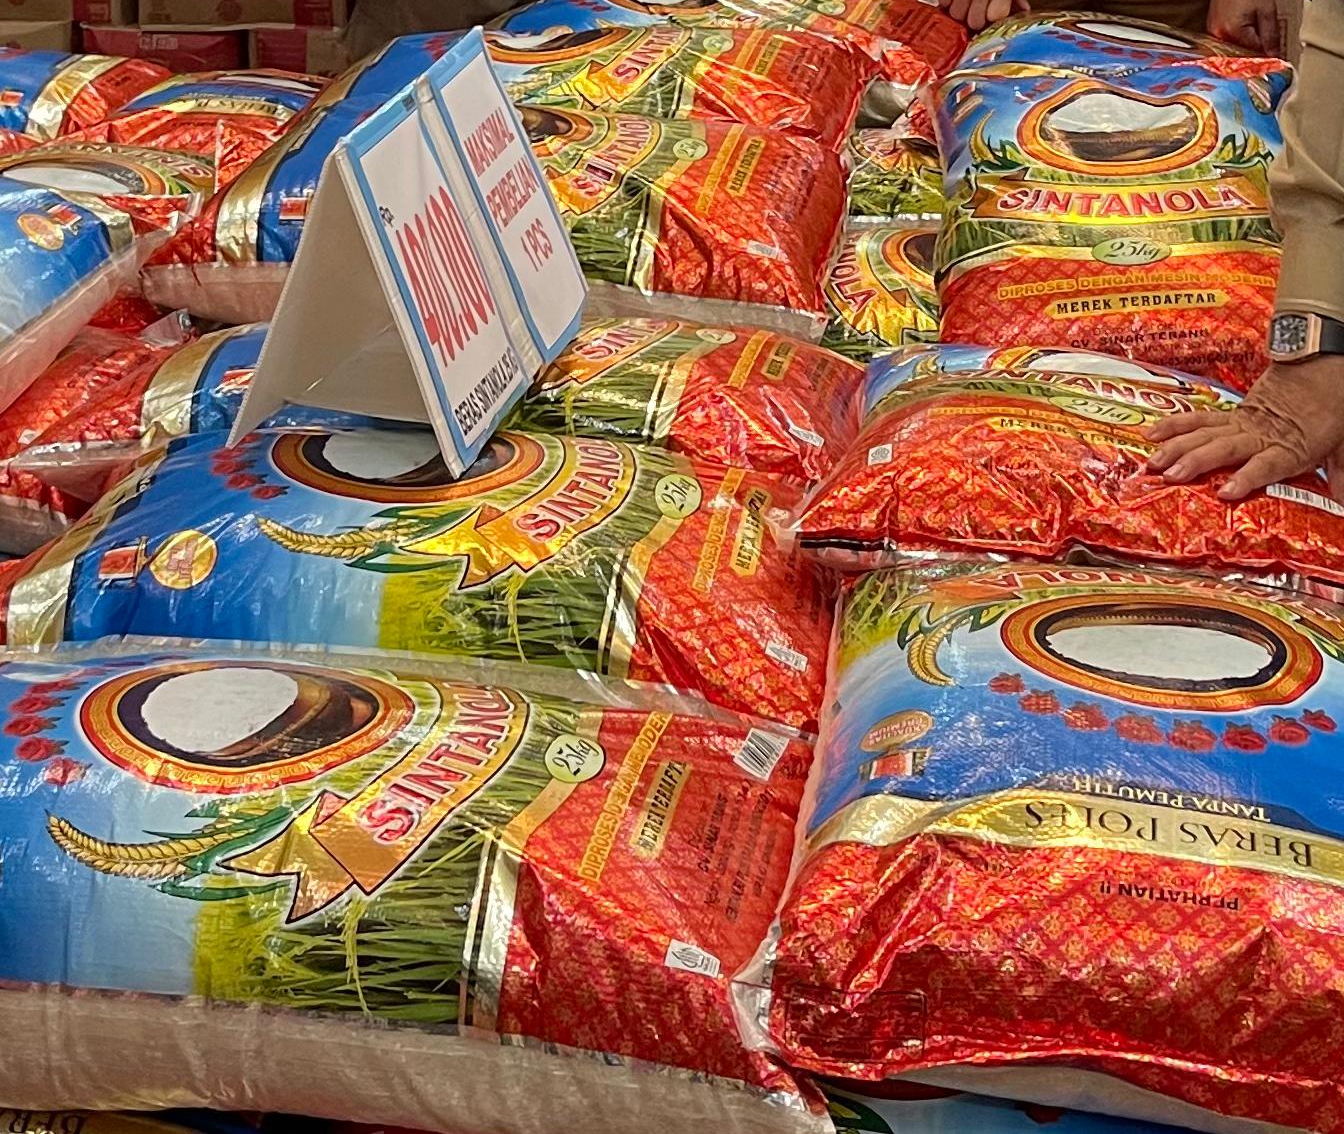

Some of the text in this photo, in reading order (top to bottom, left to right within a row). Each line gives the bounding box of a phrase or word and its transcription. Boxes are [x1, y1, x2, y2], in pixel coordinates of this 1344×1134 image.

[464, 106, 516, 178] MAKSIMAL
[486, 152, 540, 234] PEMBELIAN
[997, 185, 1256, 218] SINTANOLA
[524, 217, 554, 267] PCS
[1103, 239, 1161, 260] 25kg
[999, 279, 1077, 299] DIPROSES
[1080, 273, 1147, 291] DENGAN
[1149, 272, 1201, 285] MESIN
[1057, 292, 1217, 315] MEREK TERDAFTAR
[566, 736, 601, 777] 25kg
[1190, 796, 1271, 823] TANPA
[579, 813, 621, 881] DIPROSES
[1024, 802, 1314, 869] BERAS POLES
[1116, 881, 1240, 911] PERHATIAN
